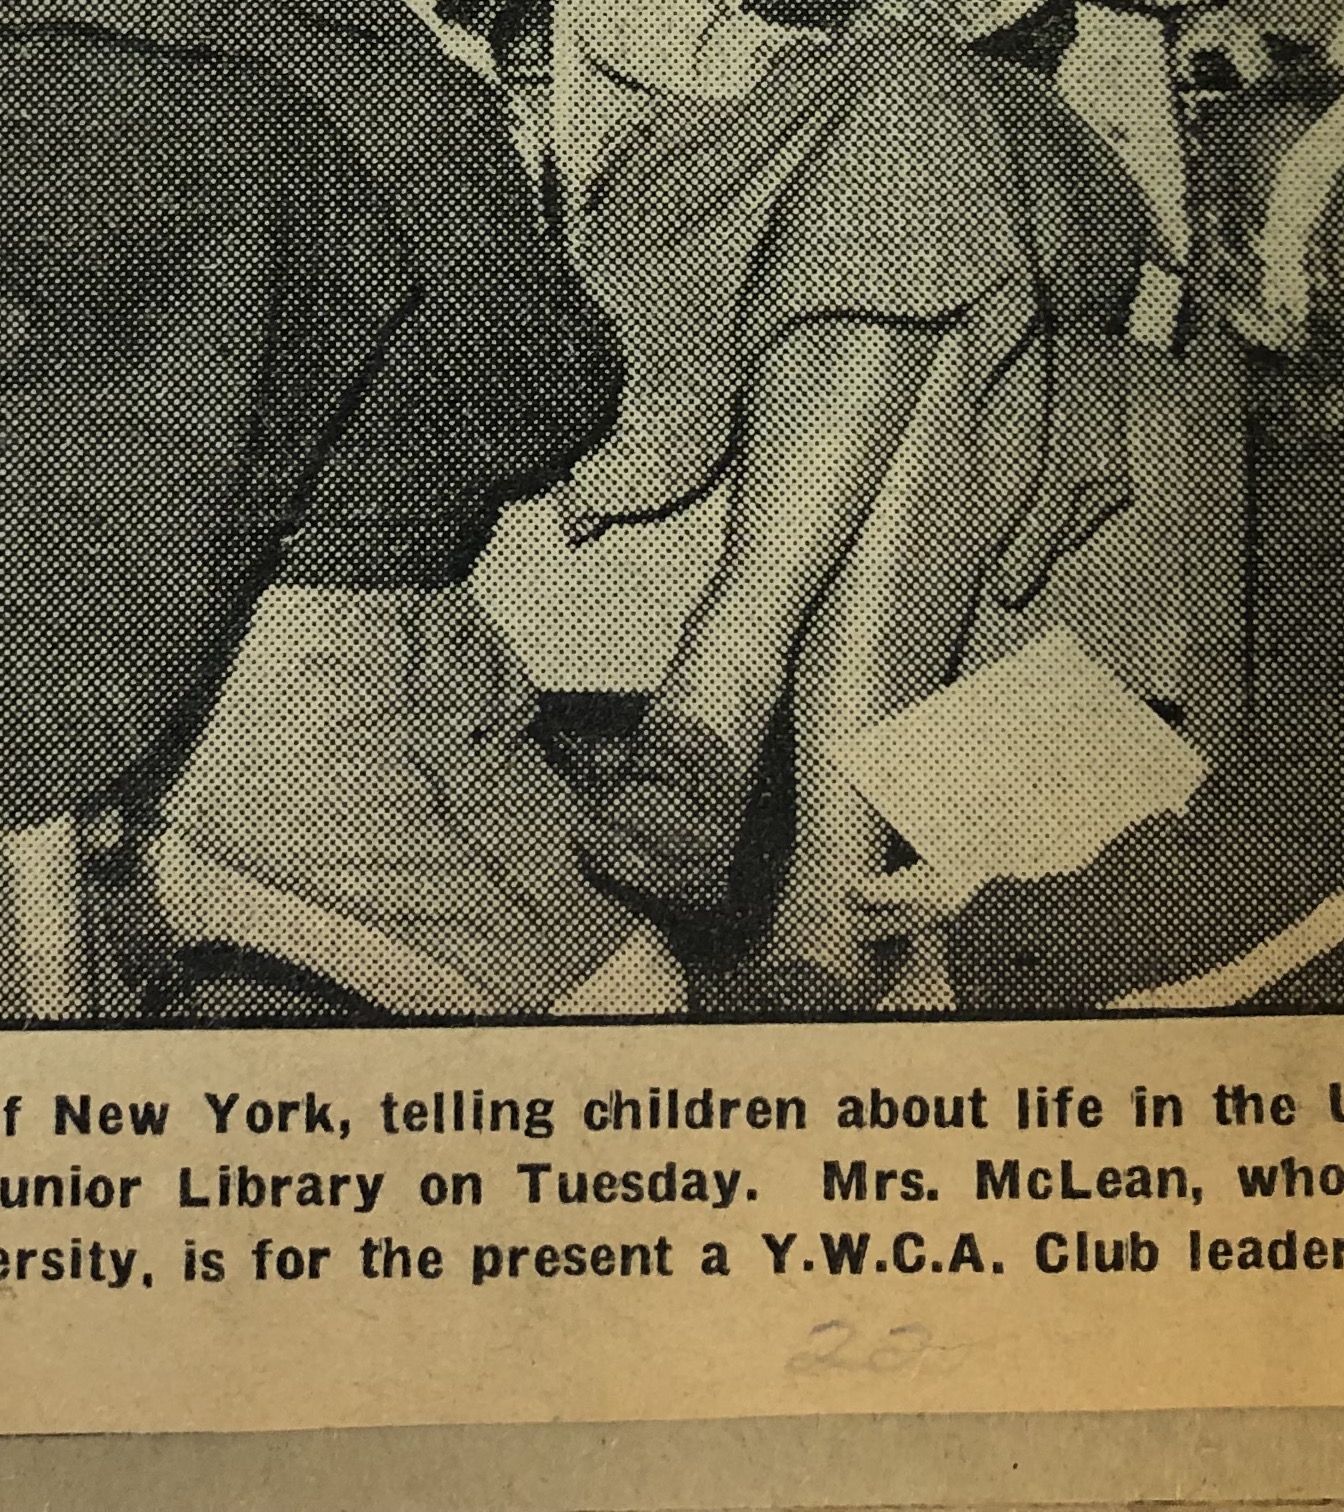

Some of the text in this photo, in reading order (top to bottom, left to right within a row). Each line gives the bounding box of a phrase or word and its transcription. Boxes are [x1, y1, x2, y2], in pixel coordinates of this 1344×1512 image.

[54, 1094, 170, 1136] New
[204, 1091, 351, 1141] York,
[379, 1088, 555, 1139] telling
[583, 1086, 807, 1132] children
[837, 1087, 989, 1130] about
[1017, 1085, 1104, 1130] life
[1134, 1085, 1183, 1128] in
[1211, 1083, 1297, 1127] the
[179, 1164, 385, 1214] Library
[419, 1171, 483, 1207] on
[516, 1161, 758, 1210] Tuesday.
[823, 1159, 939, 1202] Mrs.
[975, 1158, 1203, 1206] McLean,
[184, 1238, 226, 1283] is
[251, 1238, 332, 1281] for
[359, 1236, 444, 1280] the
[471, 1235, 674, 1287] present
[700, 1241, 731, 1277] a
[761, 1231, 1005, 1276] Y.W.C.A.
[1035, 1230, 1160, 1274] Club
